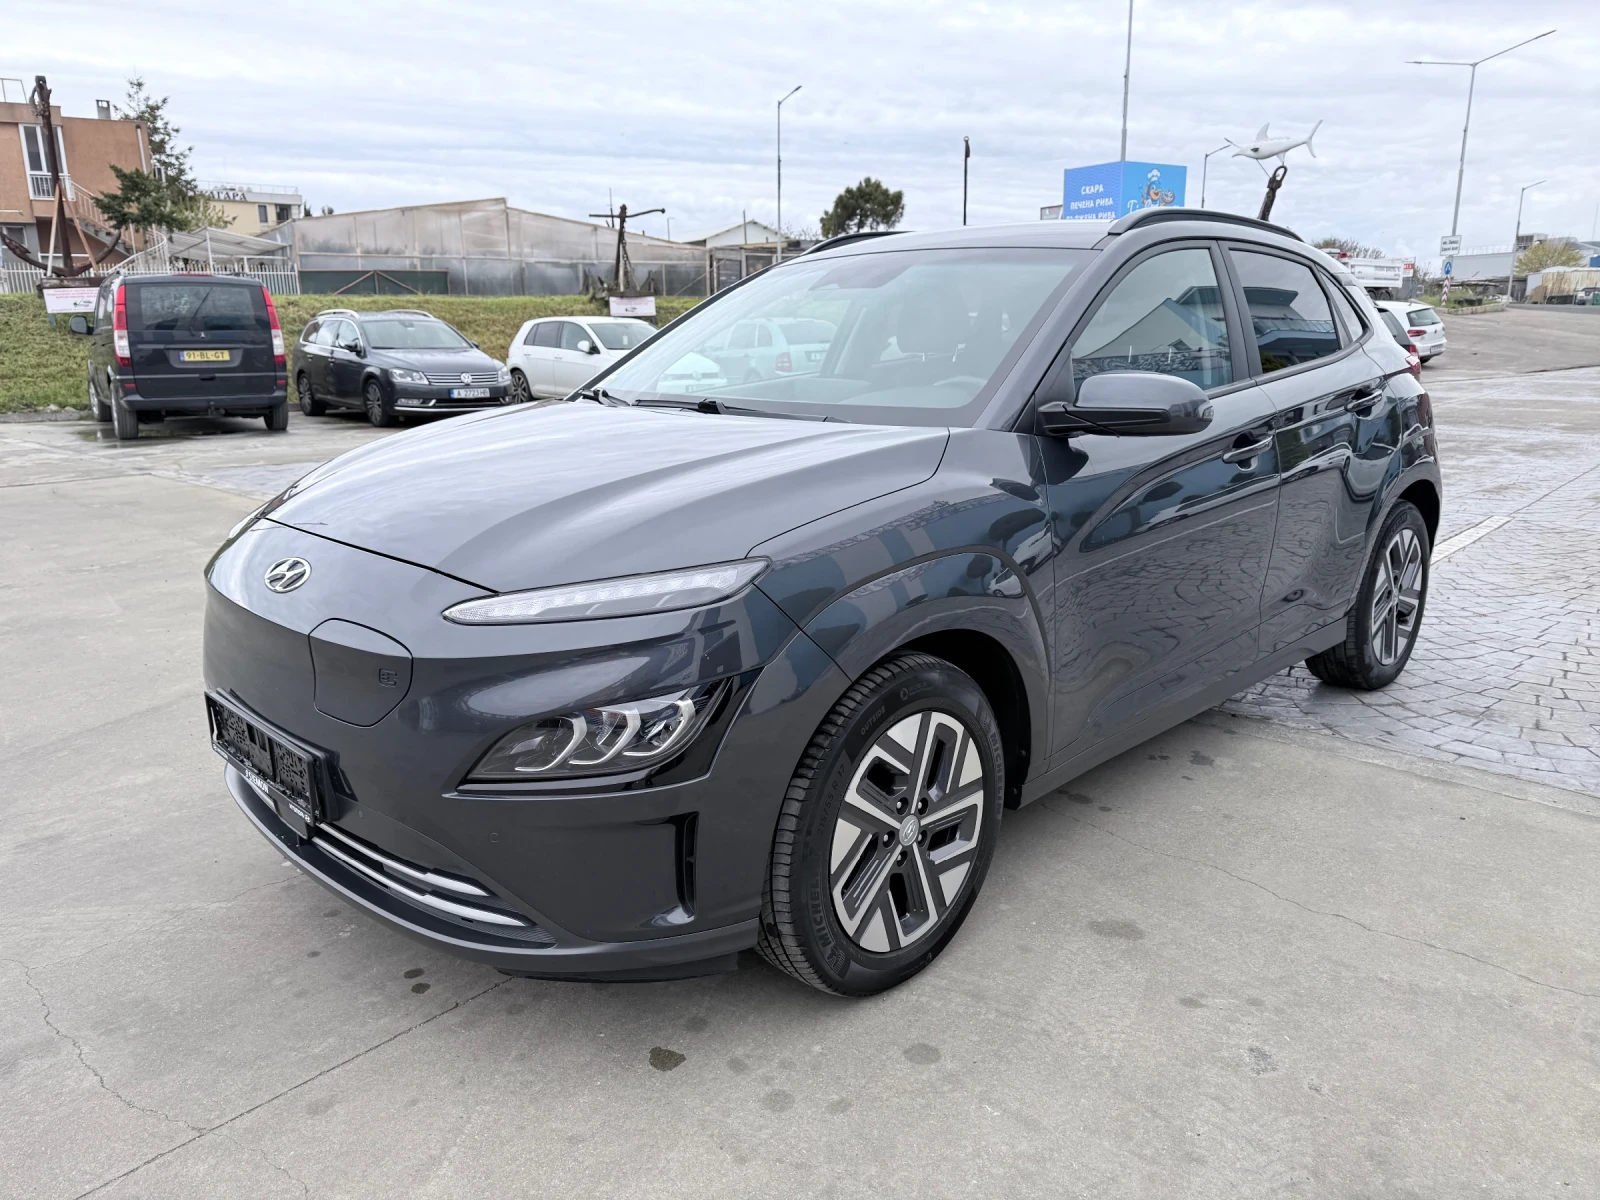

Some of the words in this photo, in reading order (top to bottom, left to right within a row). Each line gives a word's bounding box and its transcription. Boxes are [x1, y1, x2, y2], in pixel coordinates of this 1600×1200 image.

[1081, 184, 1104, 195] СКАРА
[1070, 199, 1095, 210] ПЕЧЕНА
[1096, 197, 1114, 208] РИБА
[1098, 210, 1116, 219] РИБА
[186, 351, 225, 360] 91-BL-GT
[861, 705, 887, 736] OUTSIDE
[831, 780, 839, 791] R
[838, 763, 845, 778] 17
